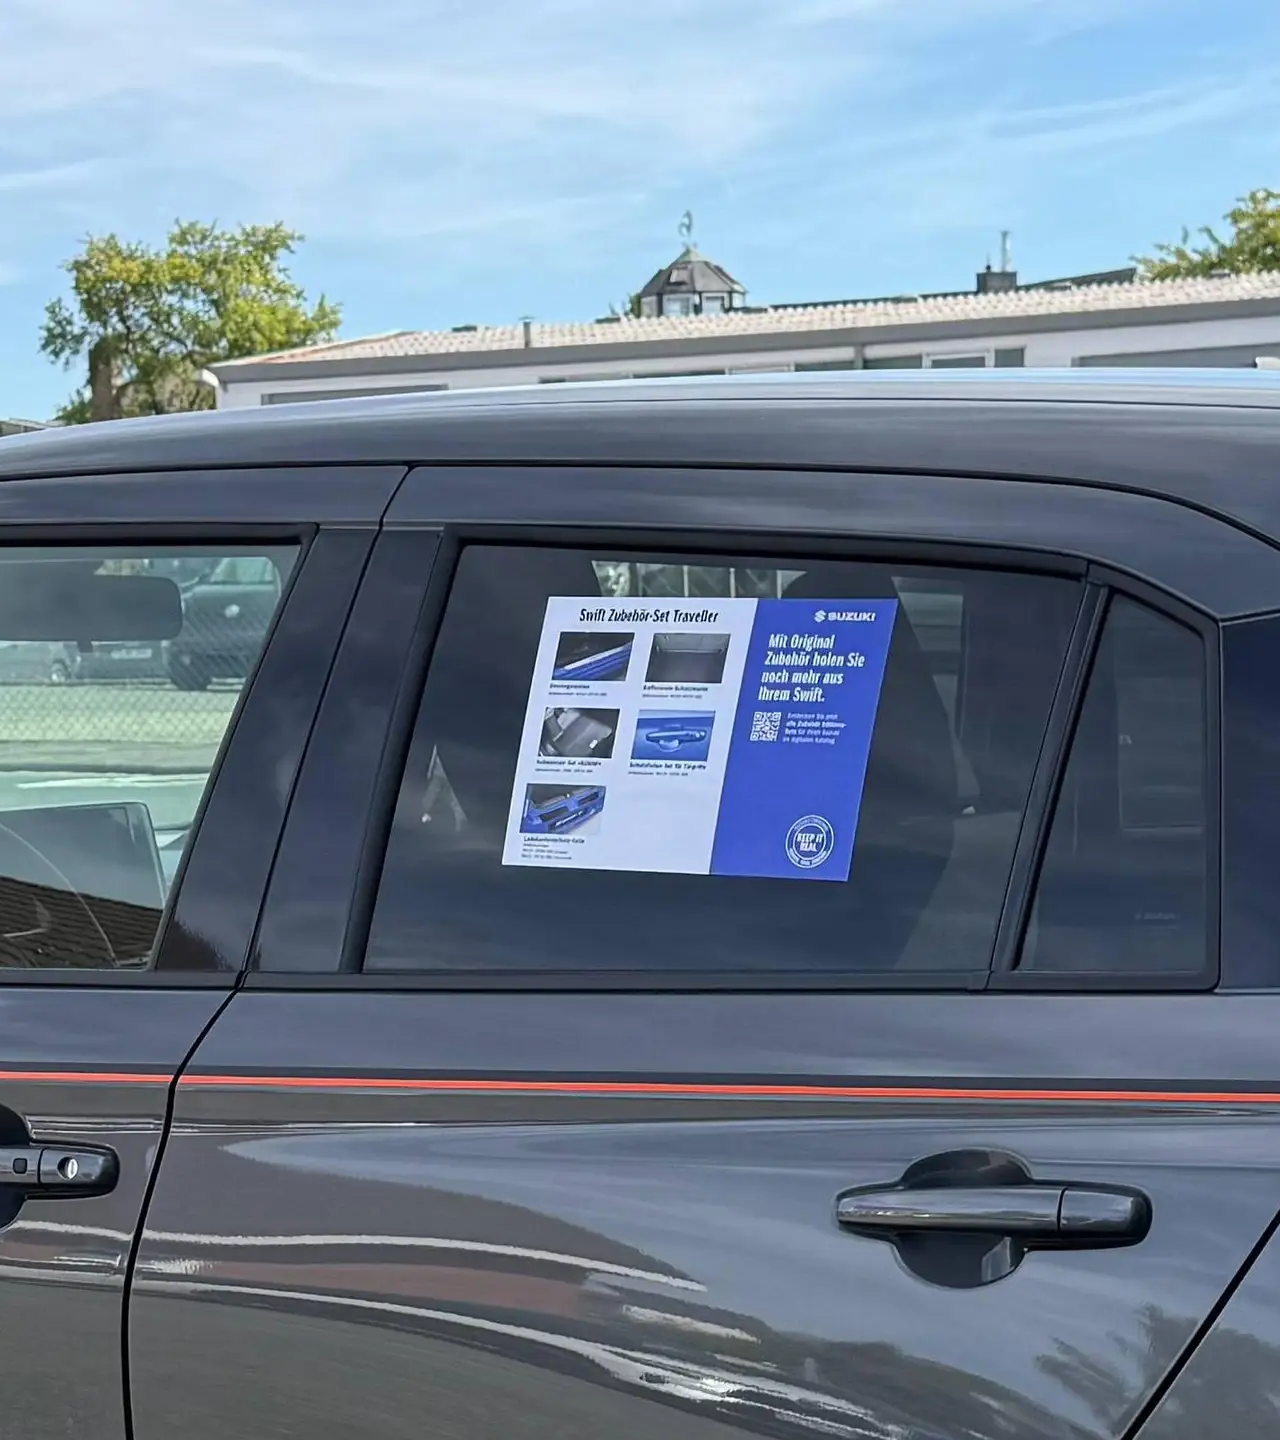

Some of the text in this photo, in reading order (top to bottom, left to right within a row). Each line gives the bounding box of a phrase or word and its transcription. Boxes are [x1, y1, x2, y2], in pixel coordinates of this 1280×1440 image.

[580, 608, 606, 622] Swift
[673, 609, 719, 623] Traveller
[827, 611, 876, 622] SUZUKI
[768, 633, 836, 652] Mit Original
[764, 651, 866, 668] Zubehör holen Sie
[761, 669, 844, 685] noch mehr aus
[758, 686, 826, 703] Ihrem Swift.
